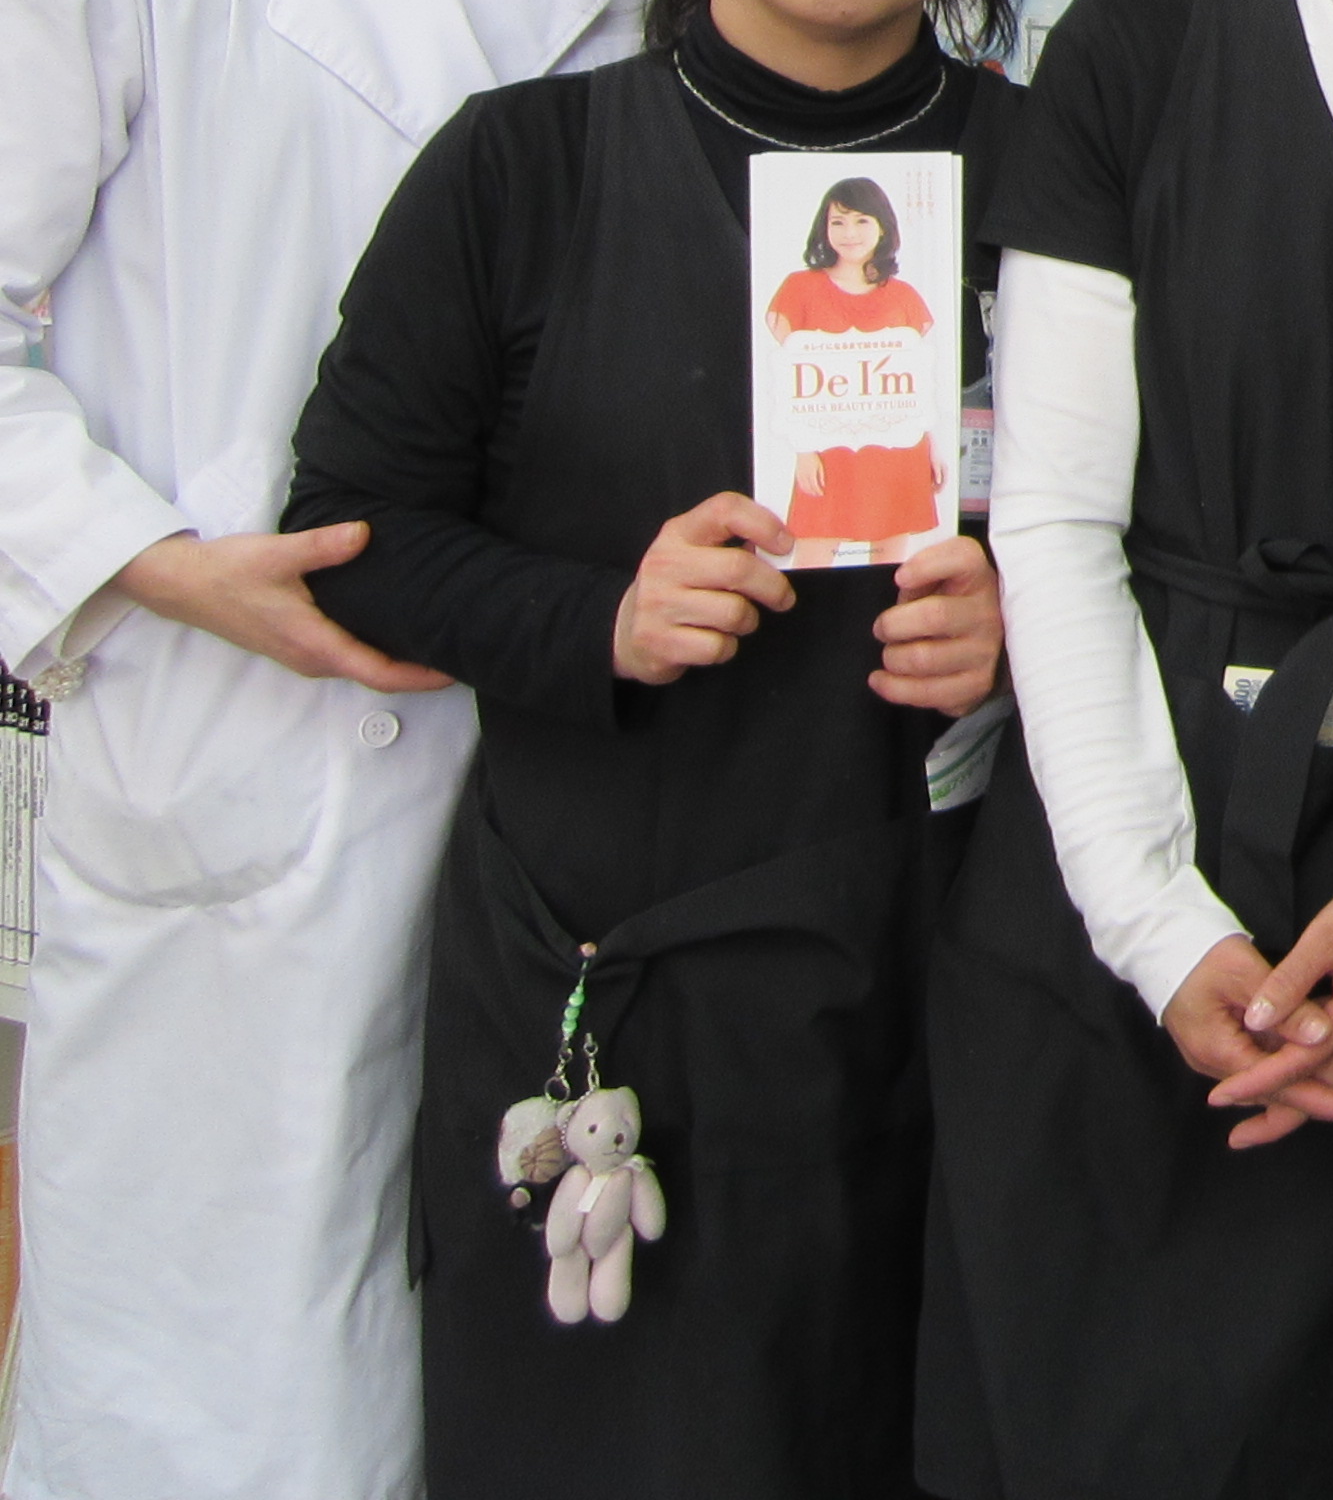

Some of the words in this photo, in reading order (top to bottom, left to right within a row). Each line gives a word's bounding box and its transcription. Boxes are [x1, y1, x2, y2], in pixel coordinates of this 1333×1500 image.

[792, 363, 849, 398] De
[830, 401, 874, 412] BEAUTY
[876, 400, 917, 410] STUDIO
